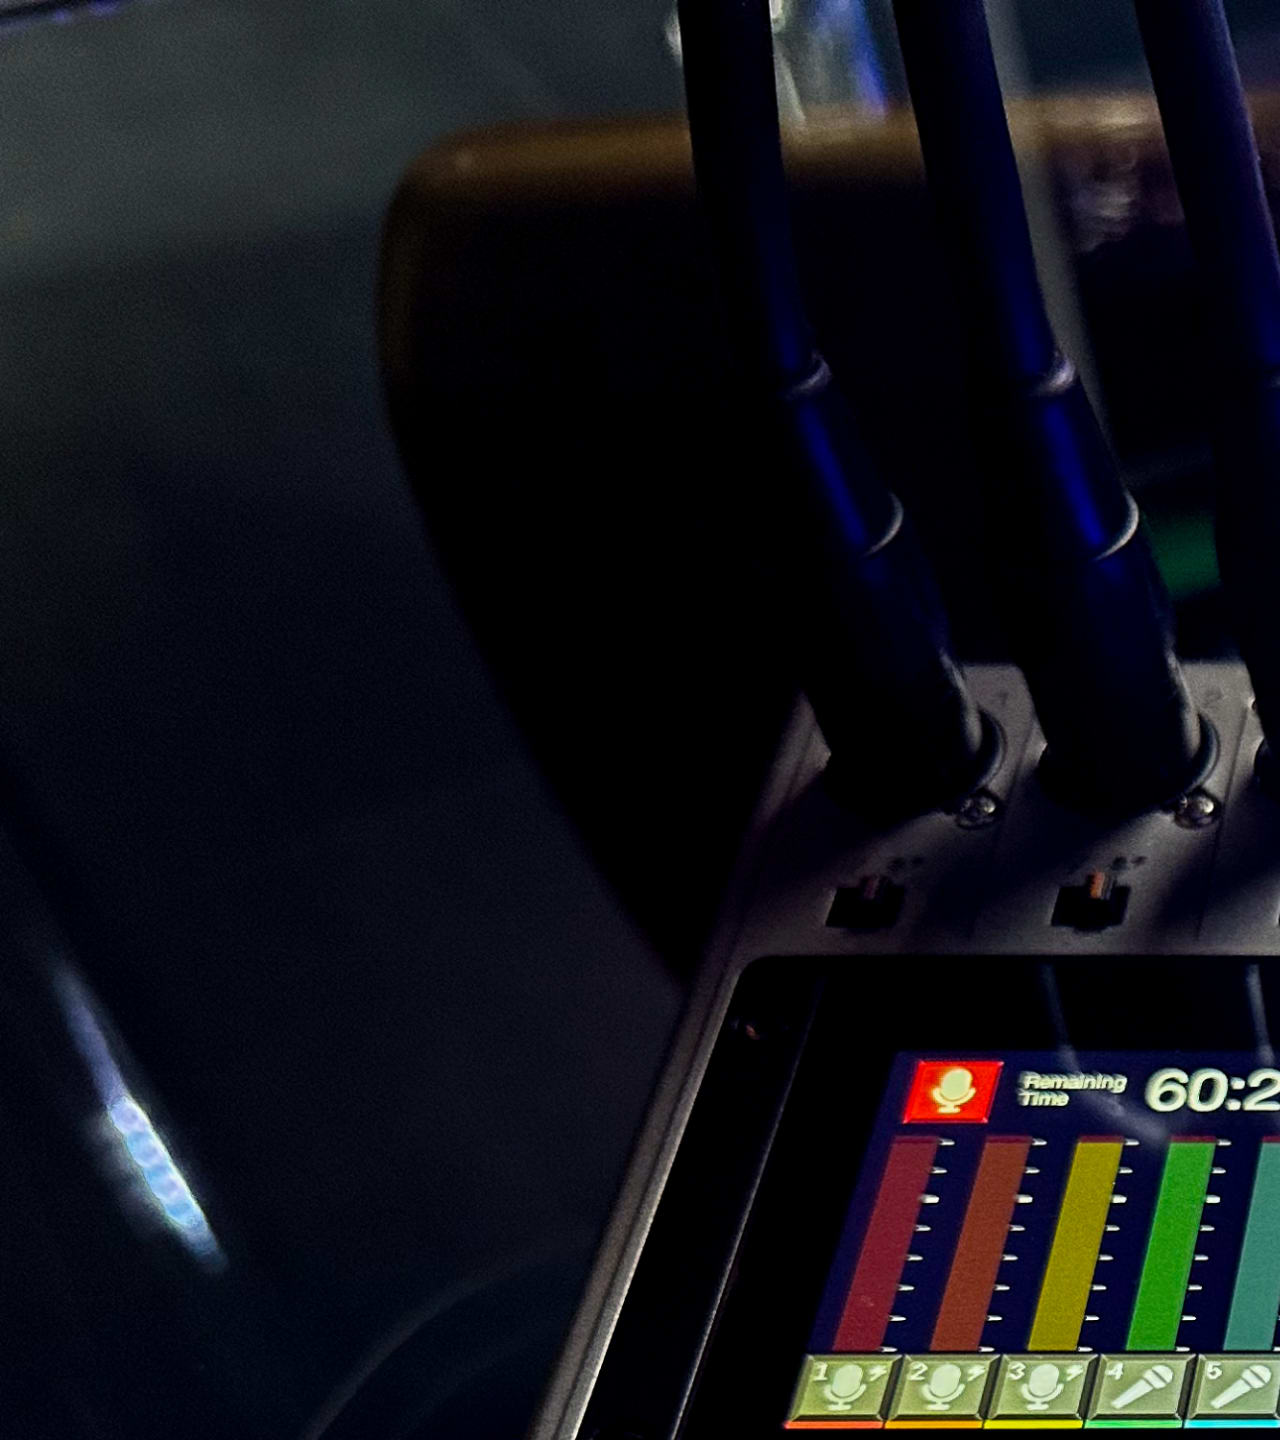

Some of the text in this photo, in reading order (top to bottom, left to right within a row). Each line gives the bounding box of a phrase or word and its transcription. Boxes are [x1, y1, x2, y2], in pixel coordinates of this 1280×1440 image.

[1021, 1071, 1128, 1093] Remaining
[1018, 1090, 1070, 1107] Time
[812, 1362, 829, 1381] 1
[908, 1363, 927, 1381] 2
[1008, 1362, 1027, 1381] 3
[1106, 1362, 1125, 1380] 4
[1206, 1362, 1222, 1380] 5
